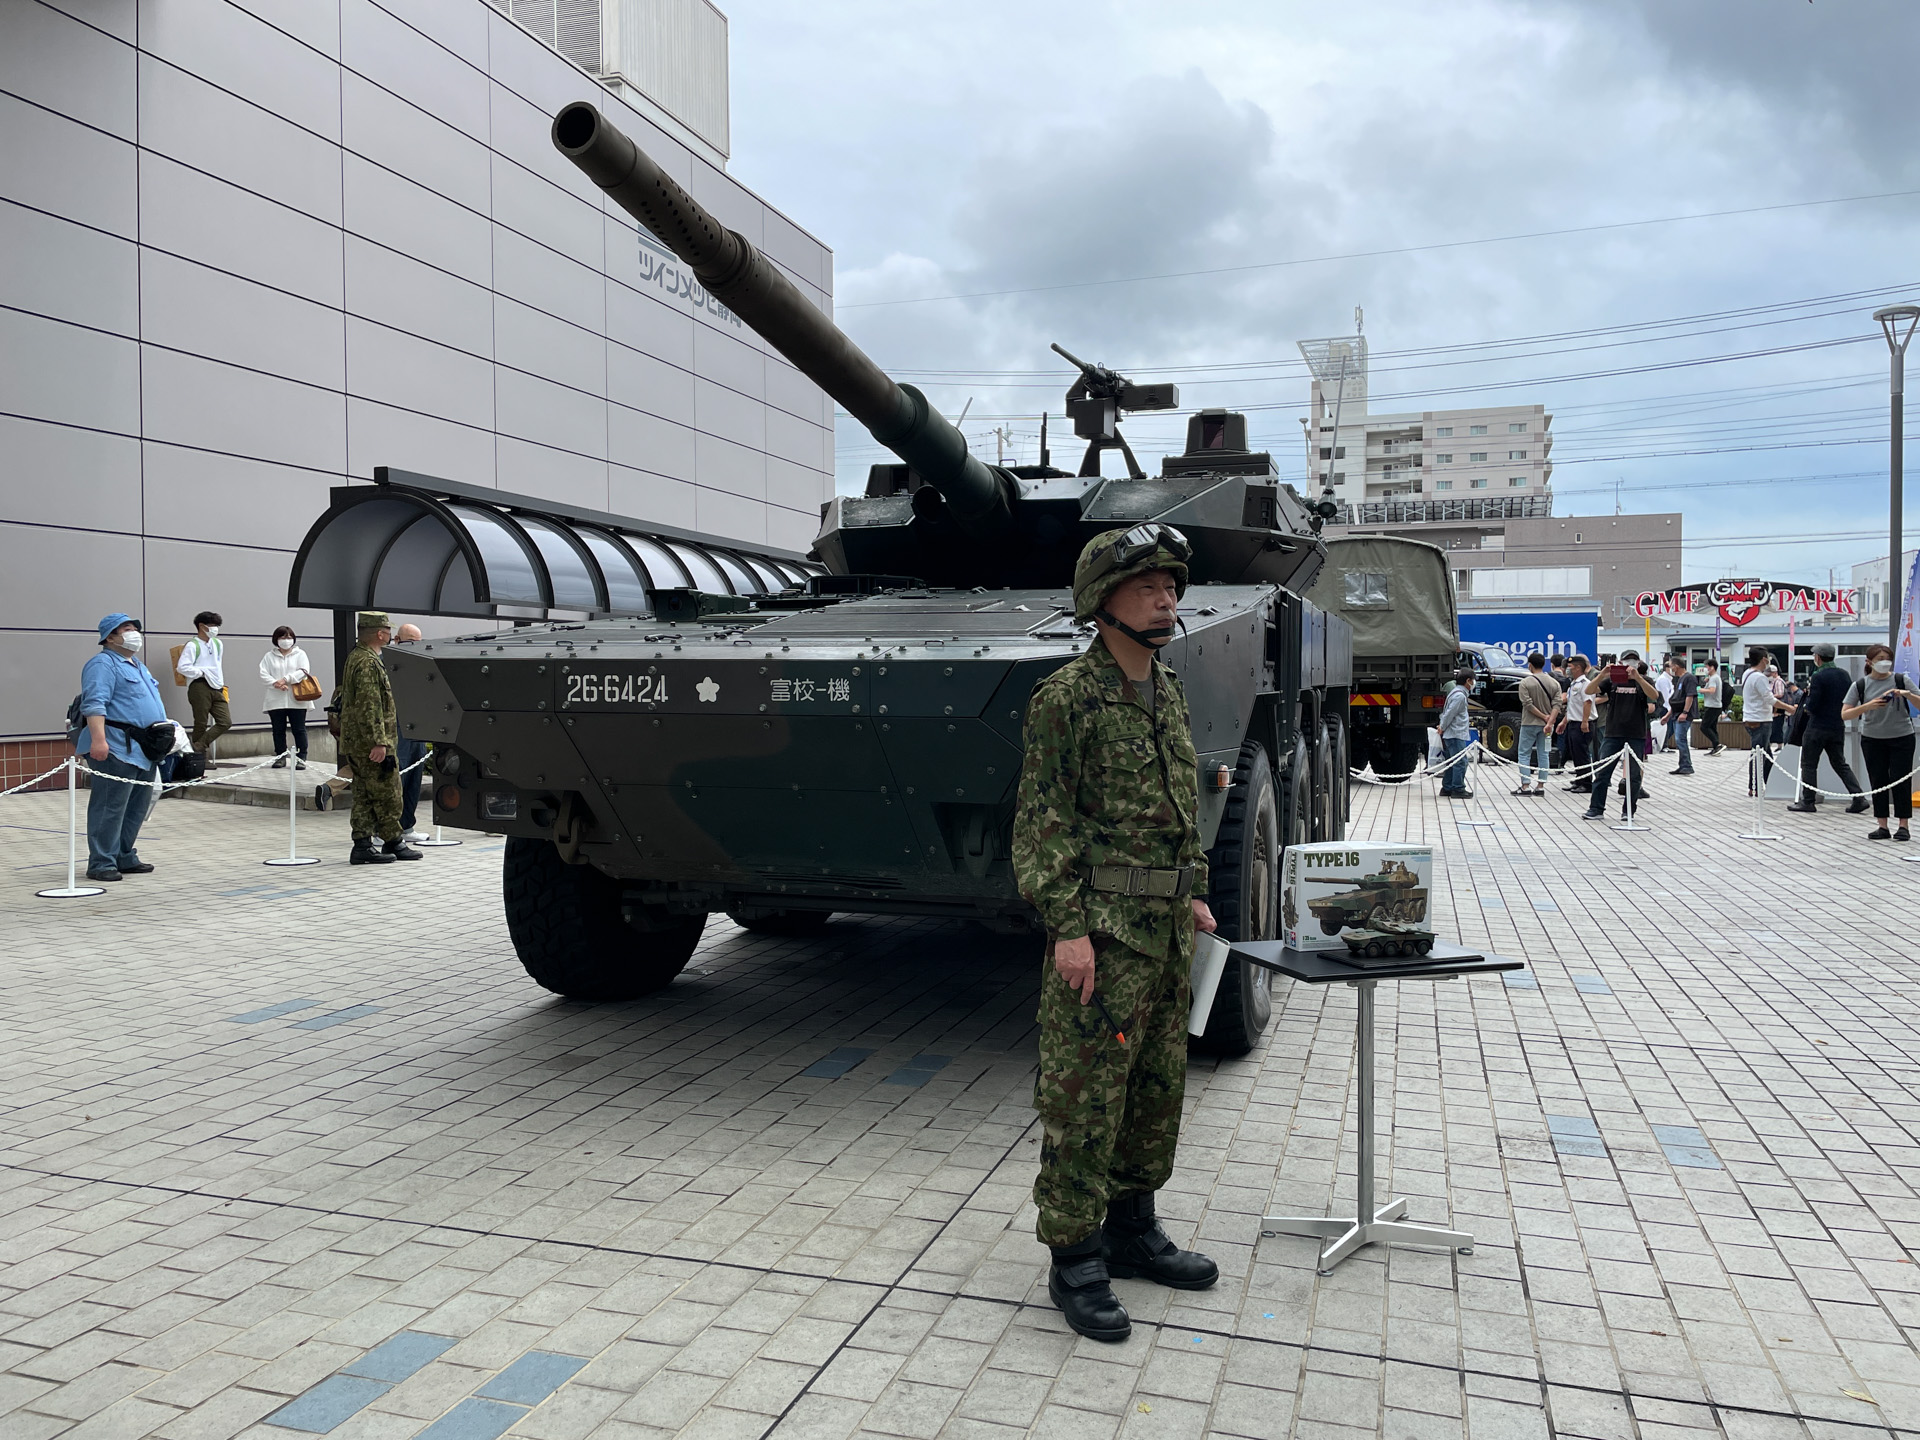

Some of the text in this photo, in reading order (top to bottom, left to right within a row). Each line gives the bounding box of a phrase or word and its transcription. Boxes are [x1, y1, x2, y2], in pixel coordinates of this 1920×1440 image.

[1714, 582, 1765, 596] GMF
[1635, 588, 1857, 618] GMF PARK
[1304, 852, 1344, 868] TYPE
[1345, 851, 1360, 867] 16
